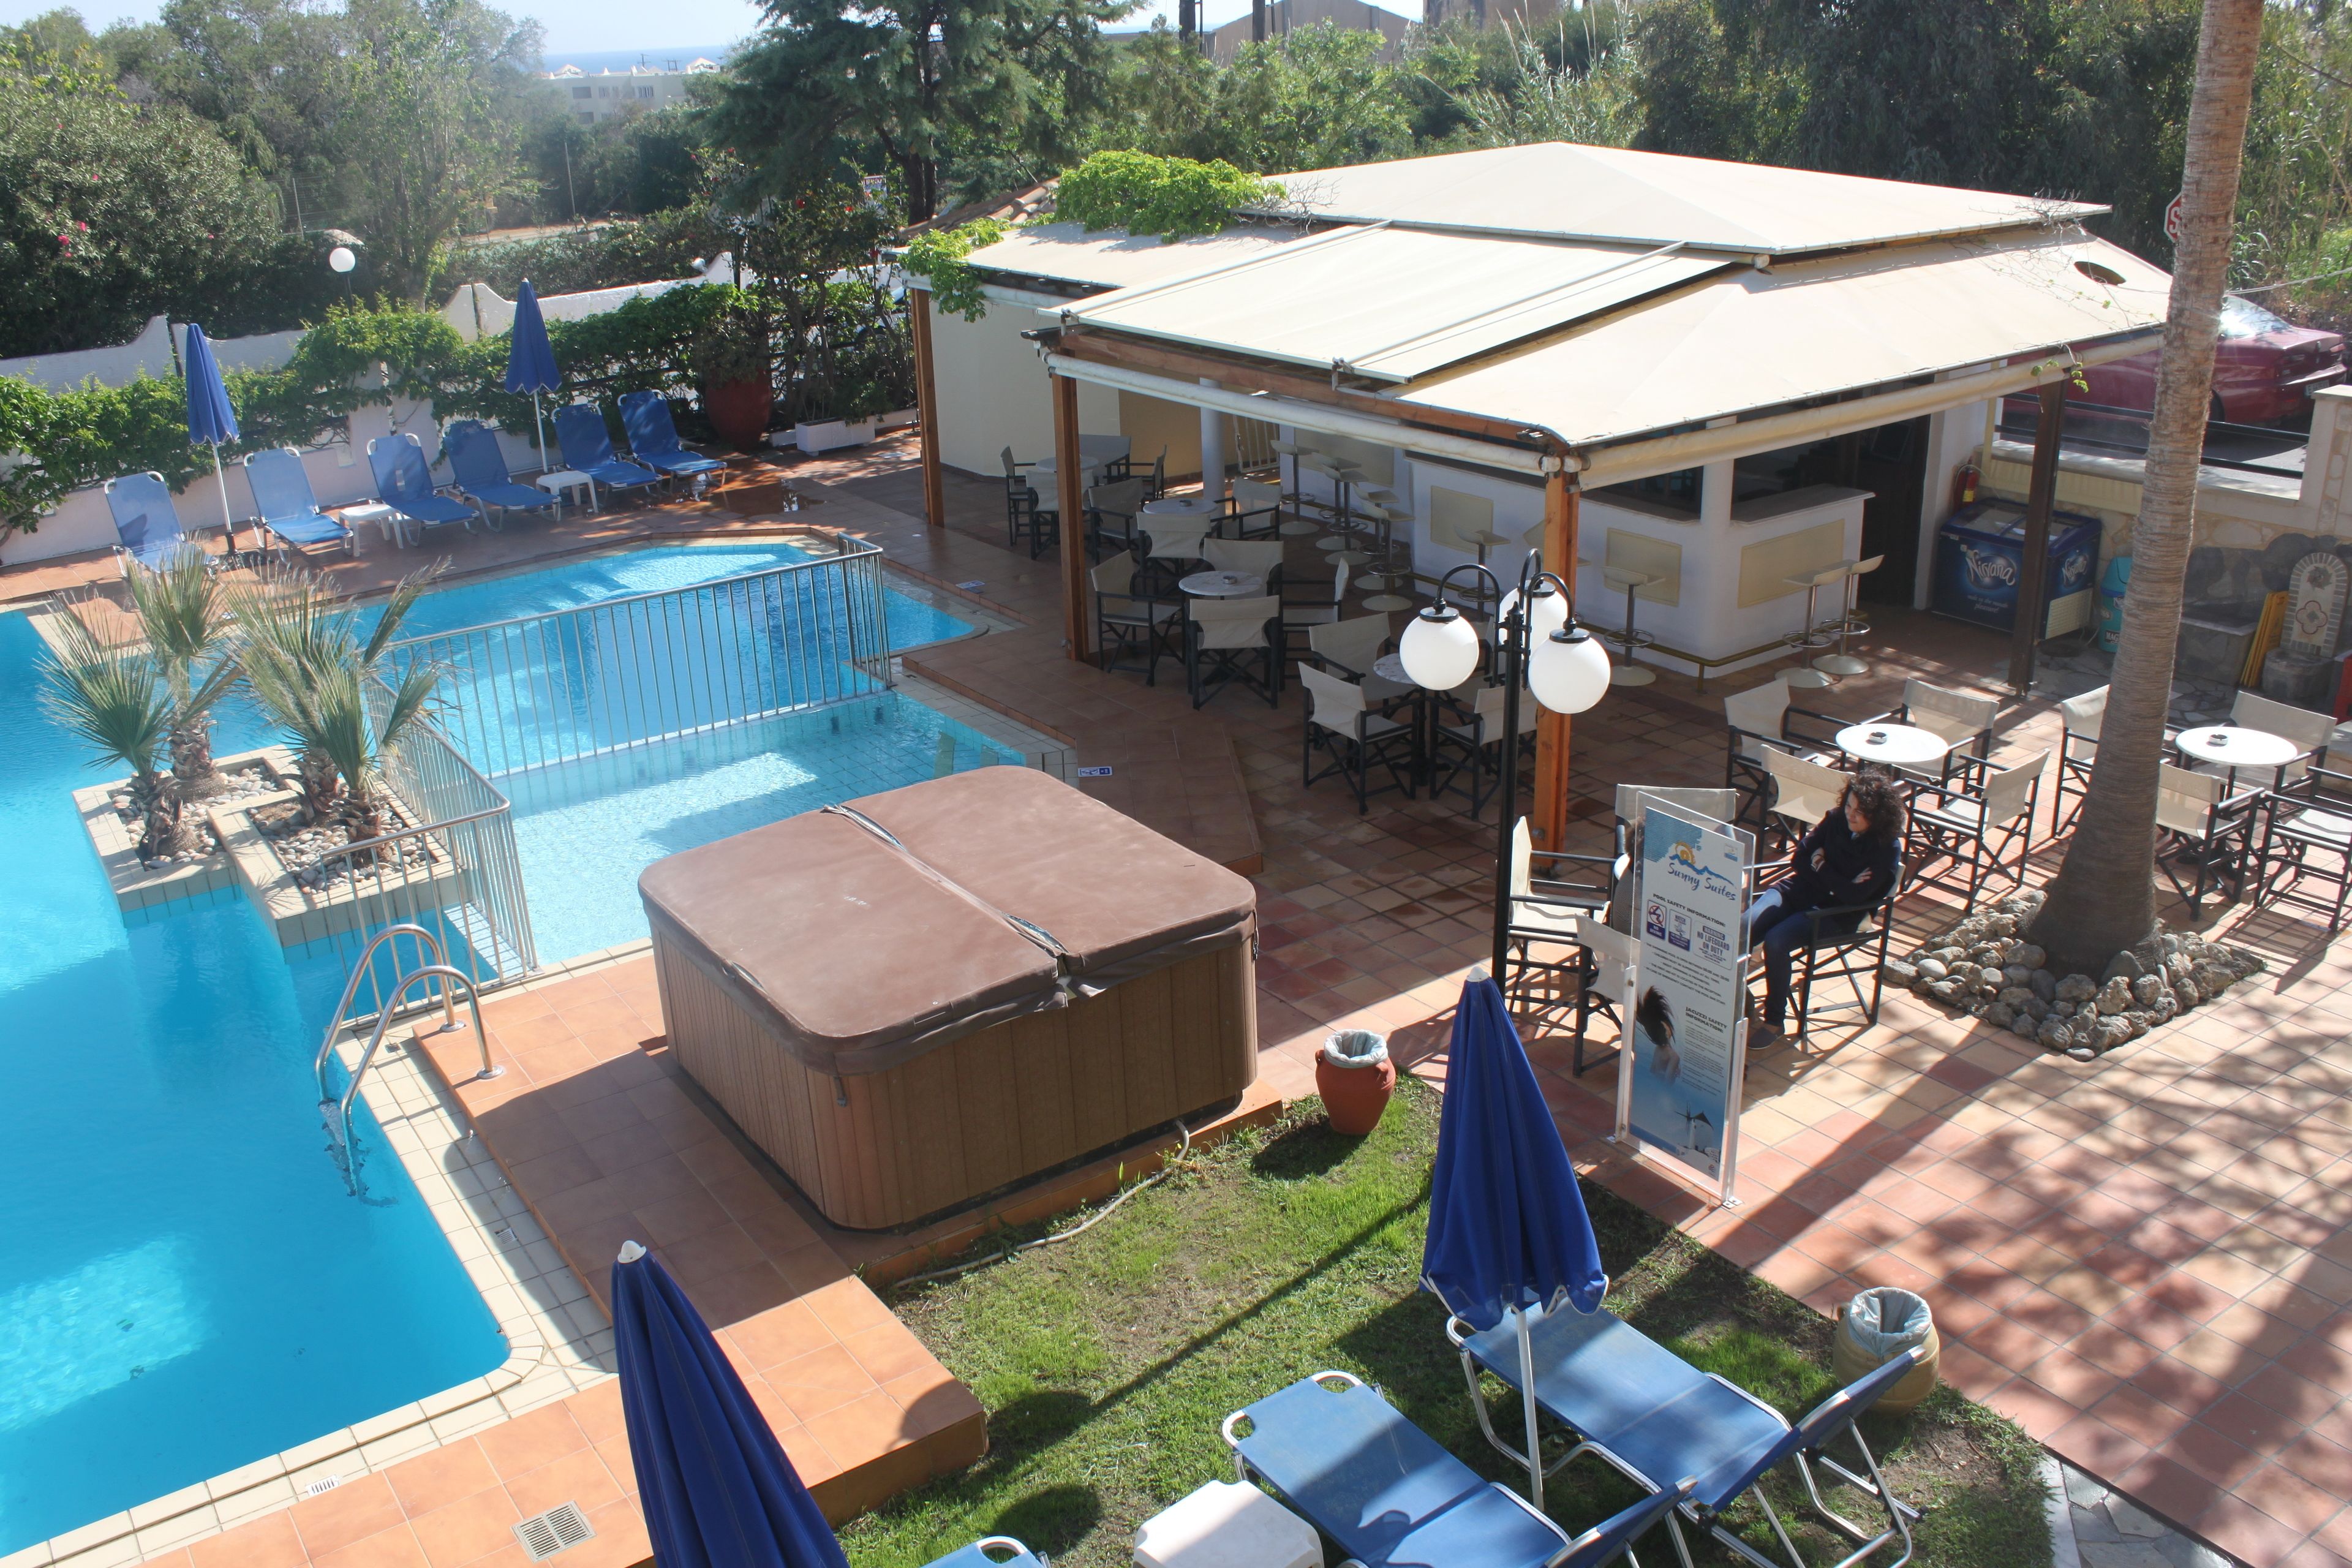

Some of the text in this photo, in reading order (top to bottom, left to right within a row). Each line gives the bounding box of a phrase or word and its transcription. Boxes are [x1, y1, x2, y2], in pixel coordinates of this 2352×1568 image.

[1966, 549, 2015, 586] Nirvana
[2106, 631, 2119, 641] MAG
[1668, 862, 1736, 900] Sunny Suites
[1653, 893, 1665, 902] POOL
[1666, 899, 1686, 910] SAFETY
[1697, 931, 1704, 940] NO
[1705, 934, 1730, 951] LIFEGUARD
[1711, 944, 1724, 956] DUTY
[1686, 1007, 1707, 1019] JACUZZI
[1708, 1017, 1727, 1029] SAFETY
